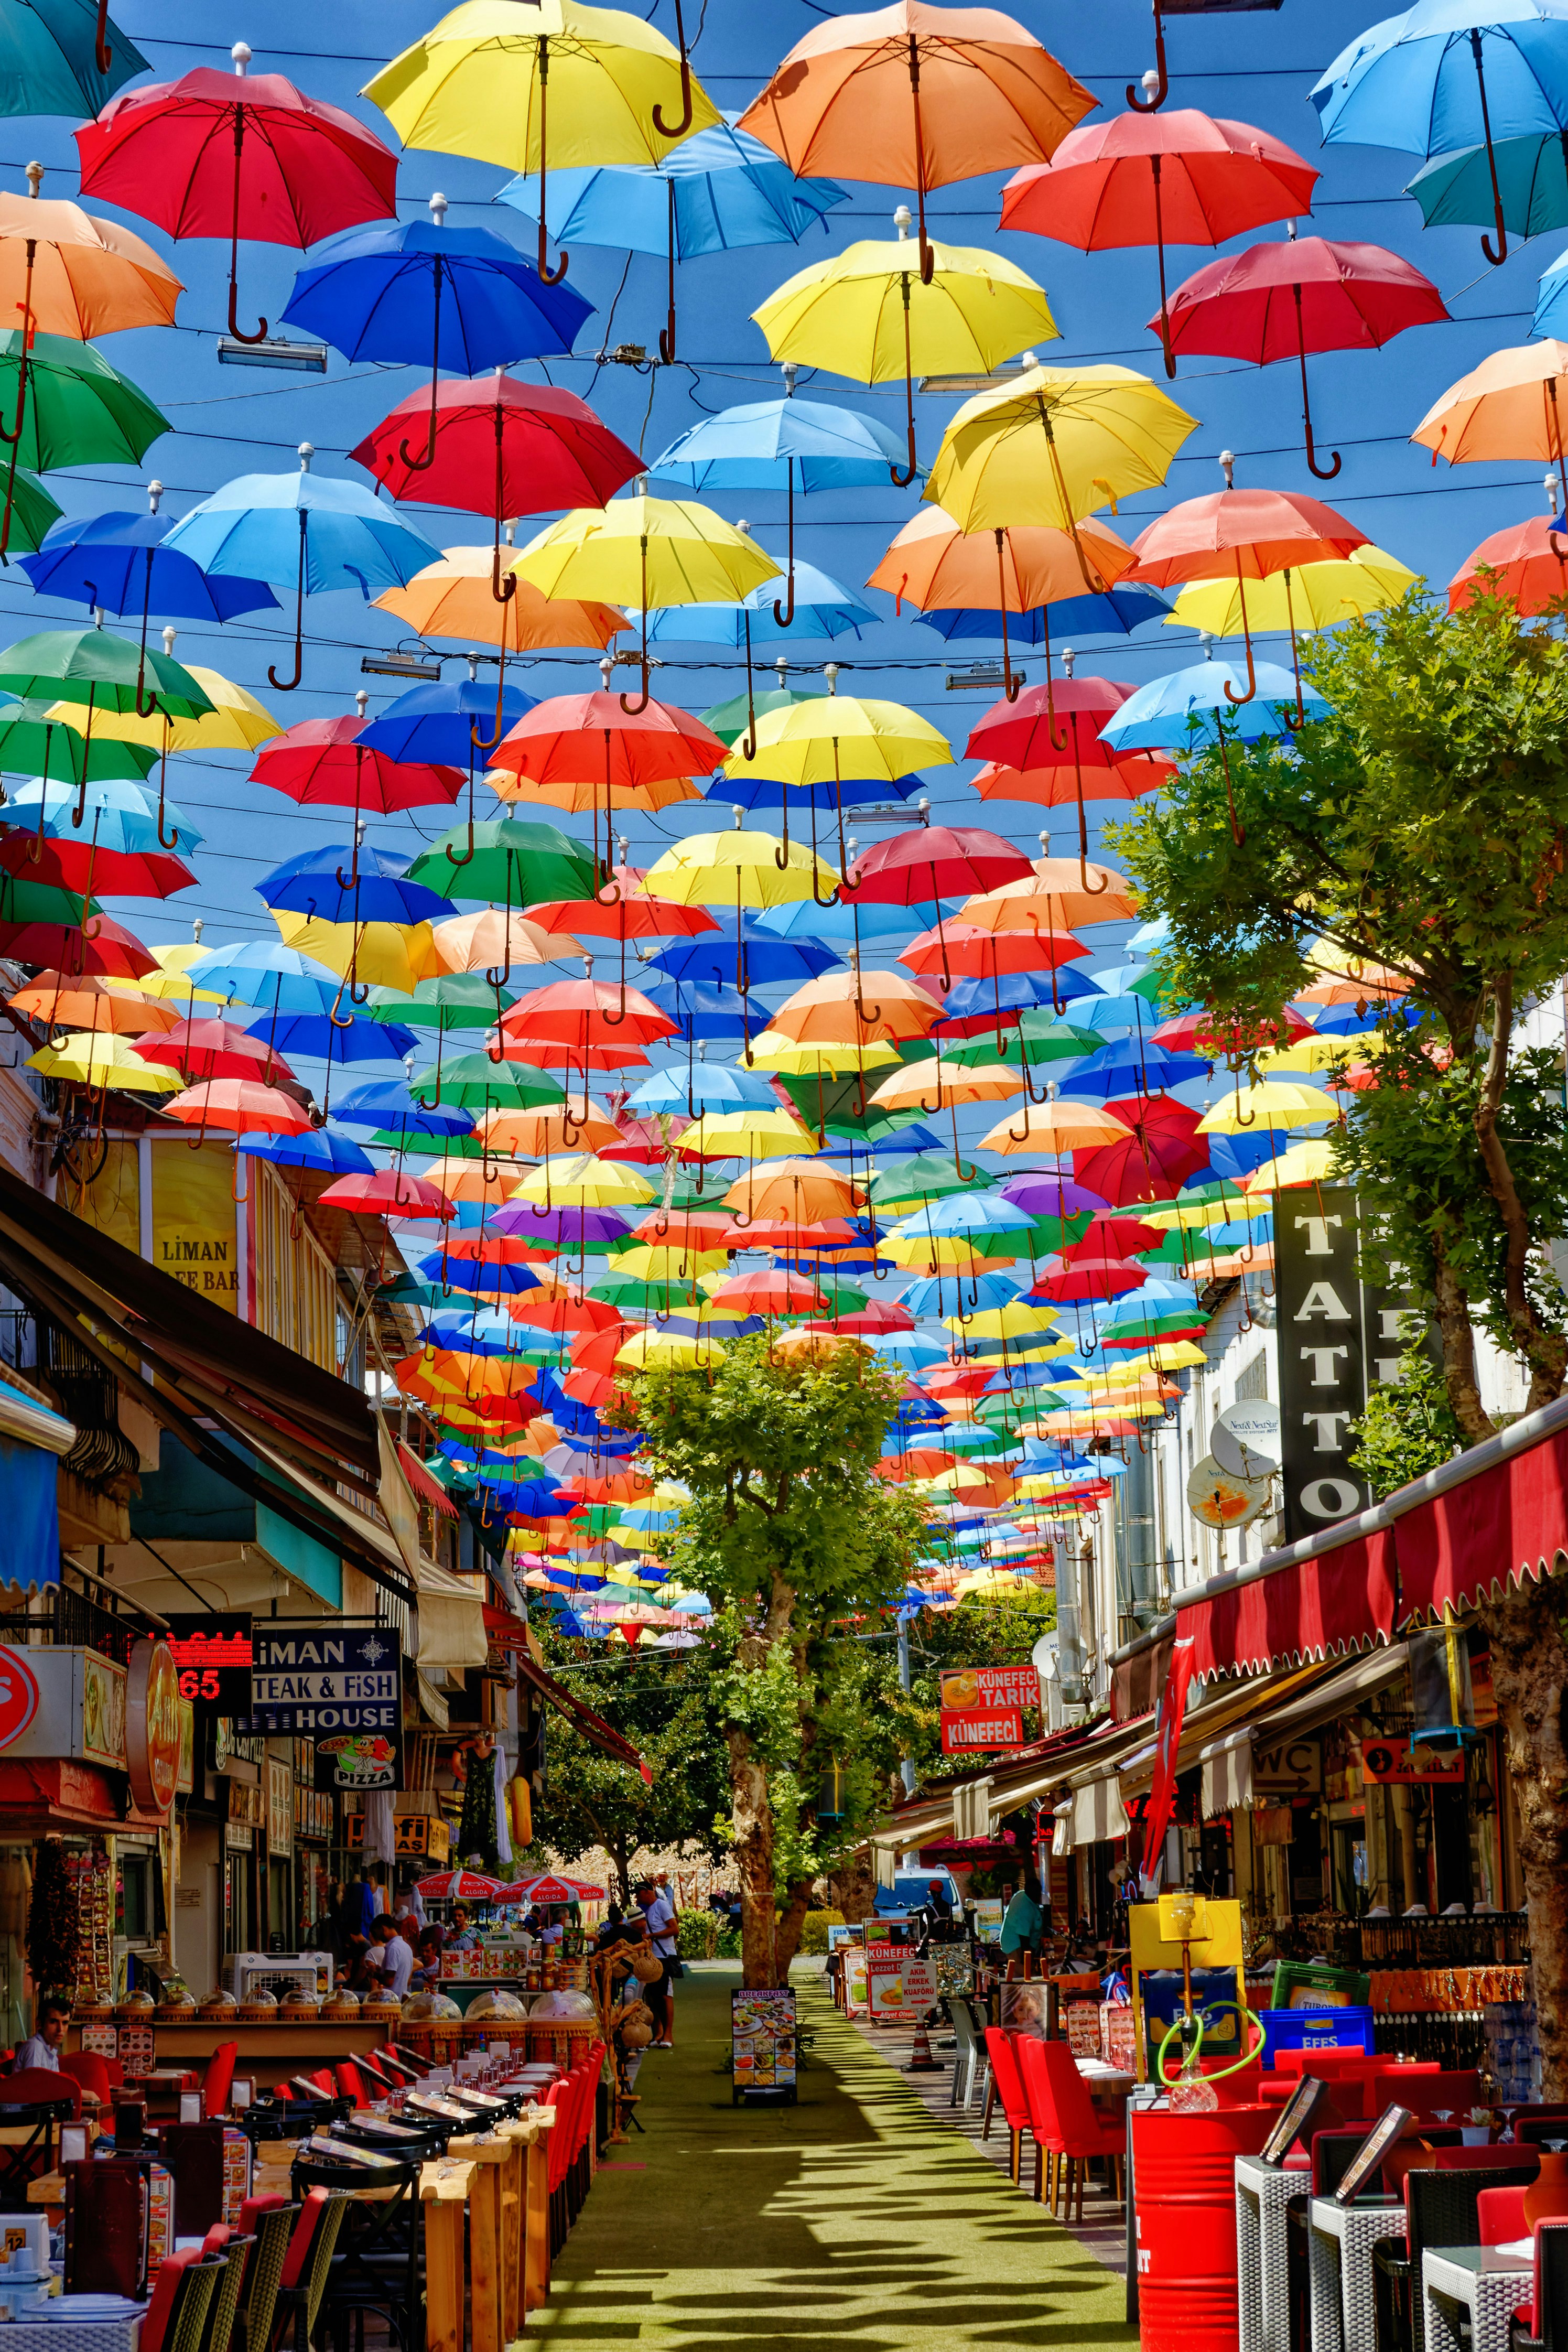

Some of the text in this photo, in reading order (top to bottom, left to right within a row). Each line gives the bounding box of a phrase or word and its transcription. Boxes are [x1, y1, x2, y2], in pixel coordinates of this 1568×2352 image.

[163, 1235, 228, 1260] LİMAN
[203, 1271, 240, 1290] BAR
[1293, 1214, 1359, 1518] TATTO
[253, 1641, 344, 1665] iMAN
[179, 1670, 220, 1699] 65
[253, 1675, 392, 1699] TEAK & FiSH
[978, 1667, 1037, 1689] KÜNEFECİ
[982, 1687, 1039, 1707] TARIK
[296, 1708, 394, 1728] HOUSE
[948, 1714, 1017, 1747] KÜNEFECİ
[1254, 1744, 1312, 1774] WC
[338, 1771, 392, 1785] PIZZA
[868, 1947, 915, 1959] KÜNEFEC
[870, 1964, 895, 1973] Lezzet
[739, 1990, 790, 1998] BREAKFAST
[904, 1986, 934, 1996] KUAFÖRÜ
[1303, 2001, 1339, 2009] TUBO
[1302, 2035, 1338, 2048] EFES
[8, 2237, 23, 2251] 12
